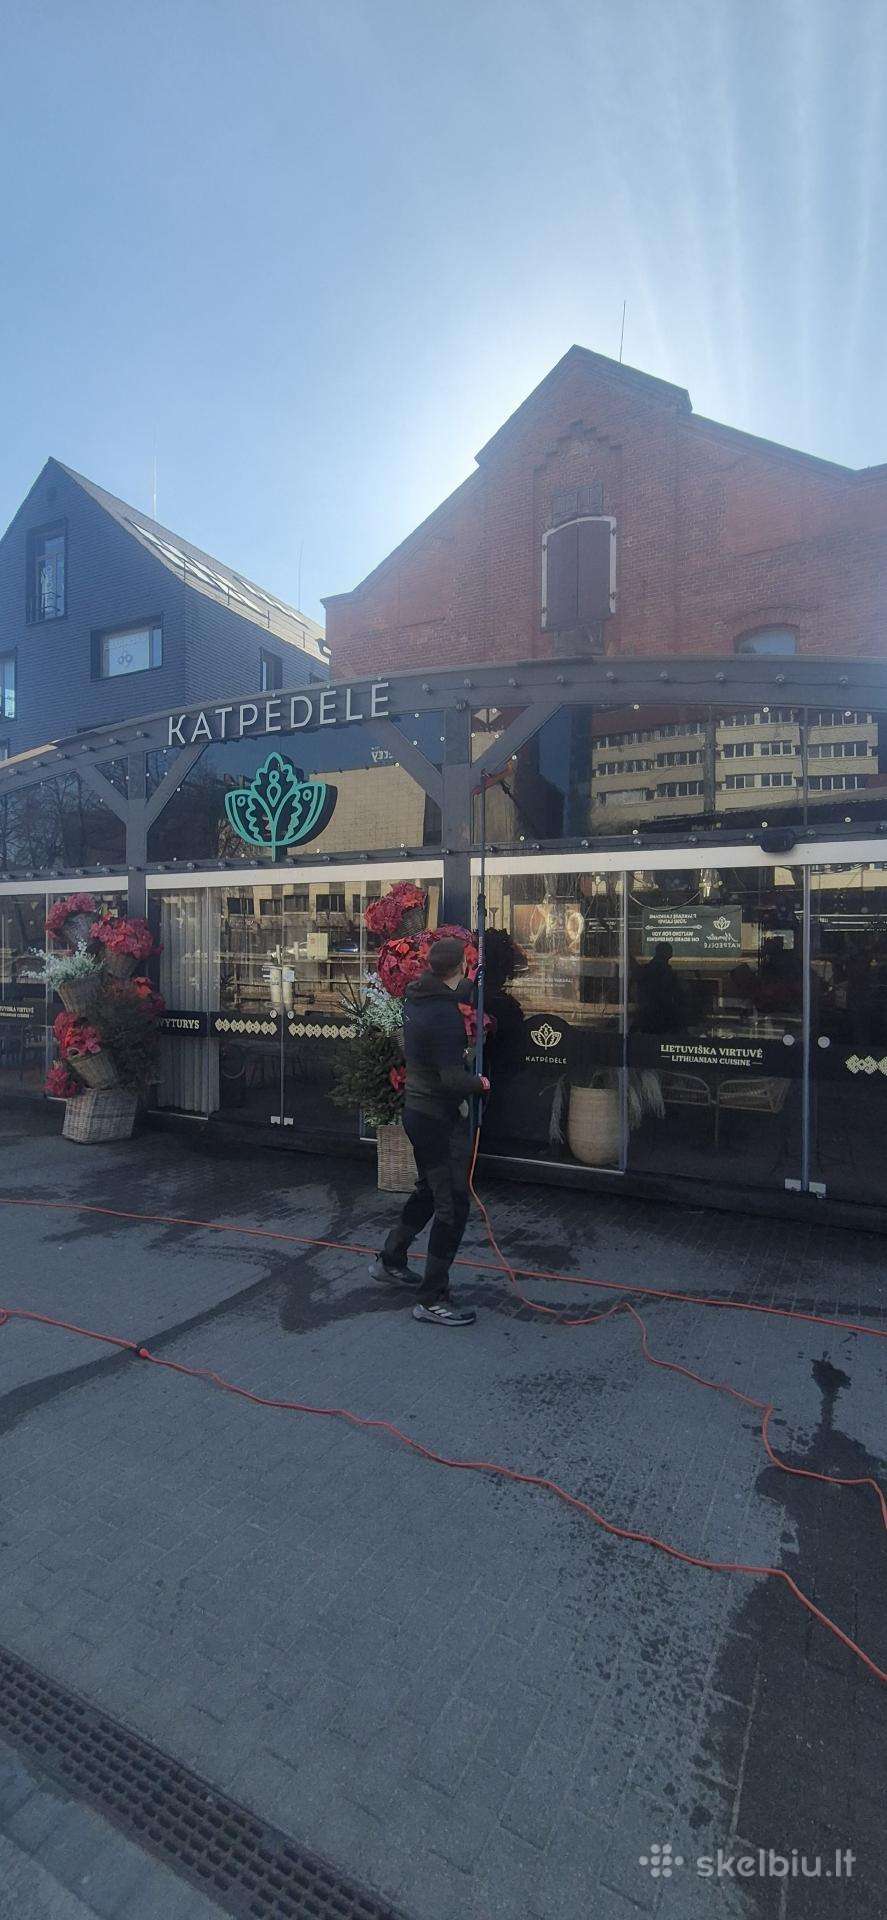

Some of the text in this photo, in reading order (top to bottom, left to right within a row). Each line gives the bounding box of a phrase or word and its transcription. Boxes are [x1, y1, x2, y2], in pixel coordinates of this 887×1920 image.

[158, 1018, 200, 1029] VYTURYS
[660, 1044, 763, 1059] LIETUVIŠKA VIRTUVĖ
[671, 1054, 751, 1067] LITHUANIAN CUISINE
